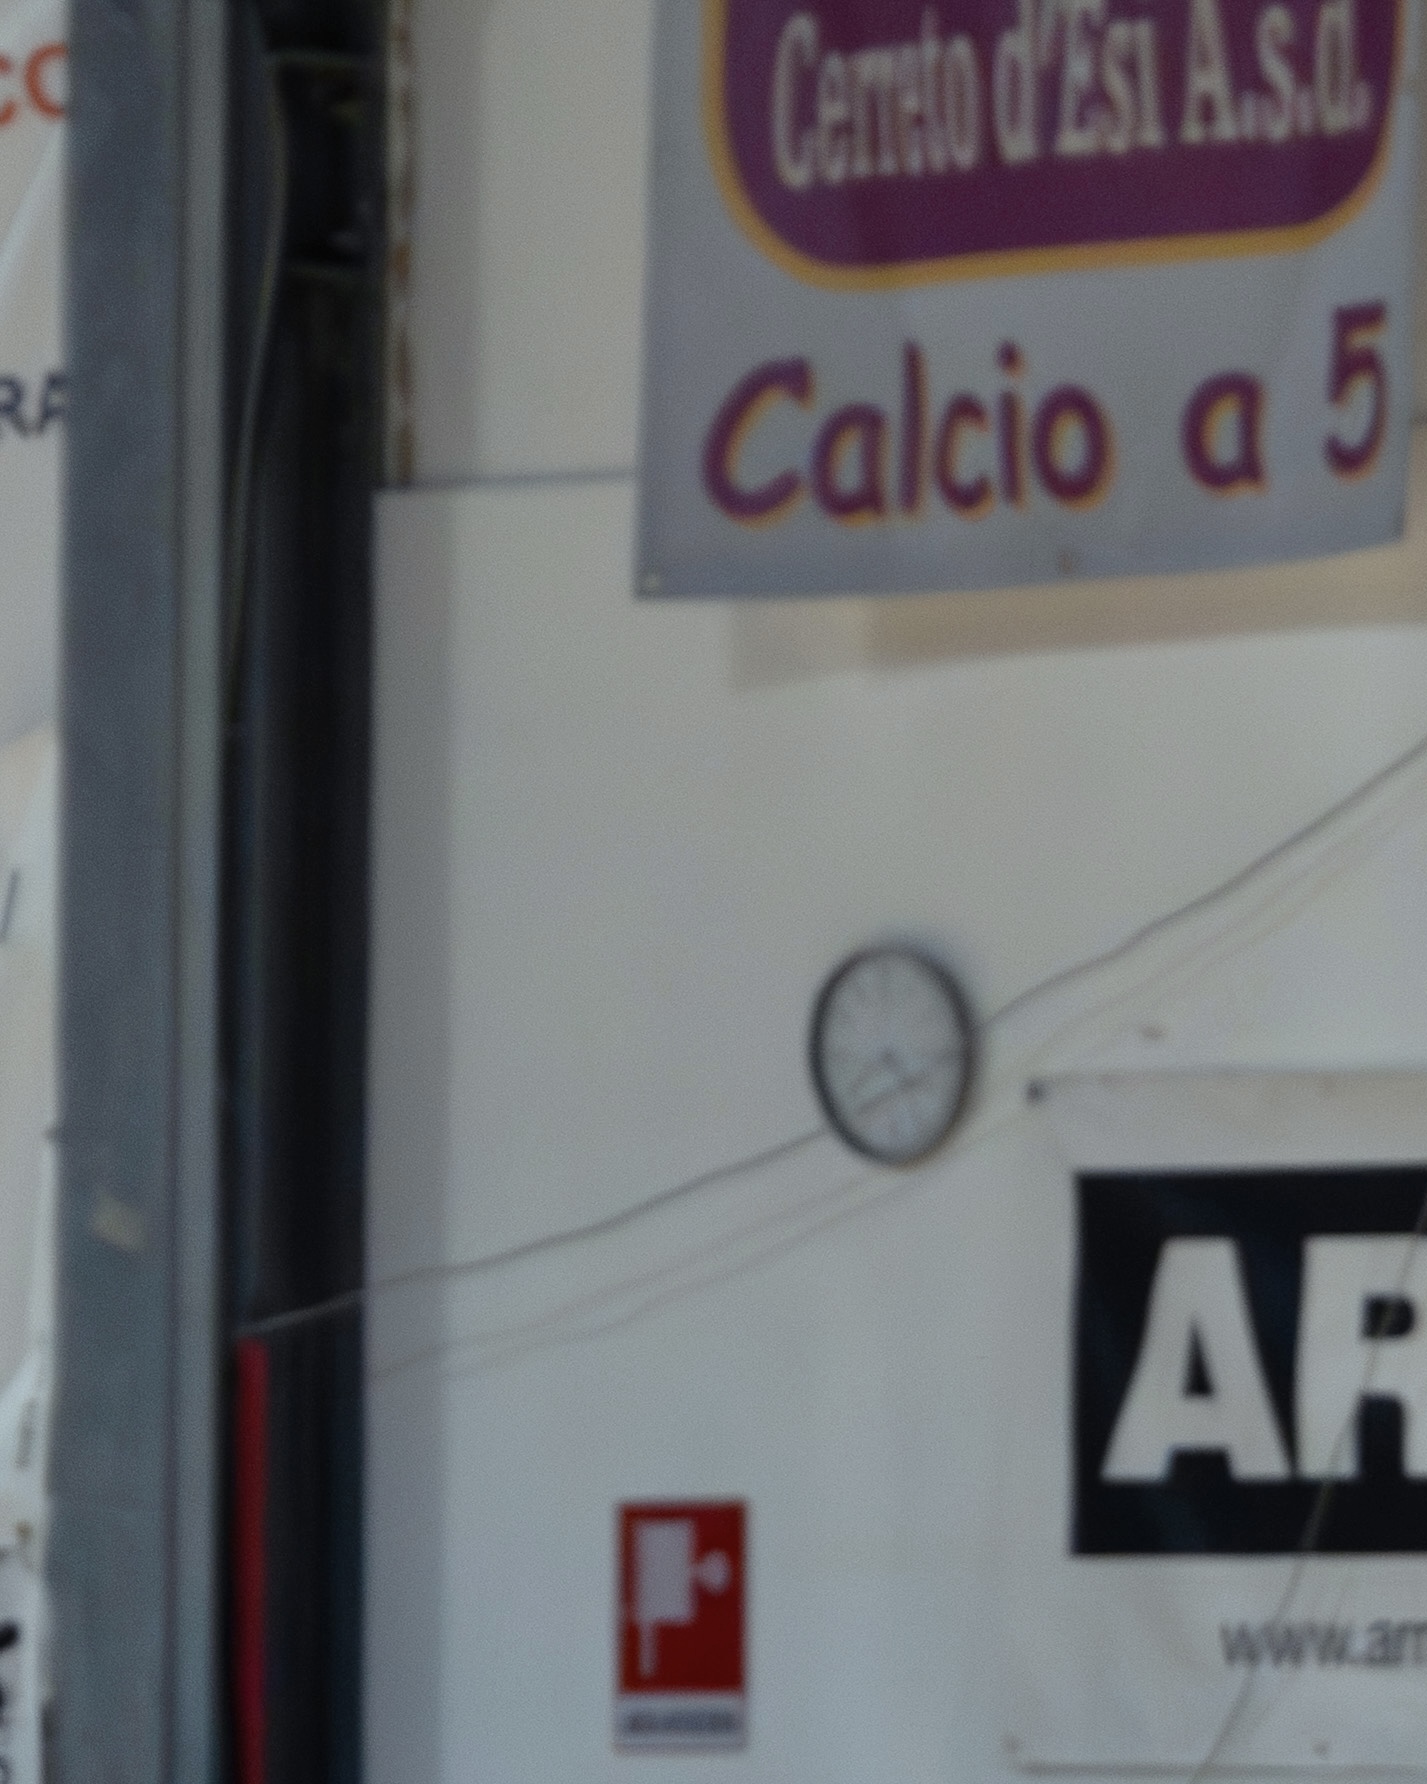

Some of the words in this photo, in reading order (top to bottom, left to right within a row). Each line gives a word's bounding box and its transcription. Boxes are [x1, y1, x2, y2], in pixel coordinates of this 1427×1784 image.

[773, 6, 985, 190] Cerreto
[700, 338, 1119, 530] Calcio
[1179, 369, 1268, 496] a
[1321, 298, 1391, 480] 5
